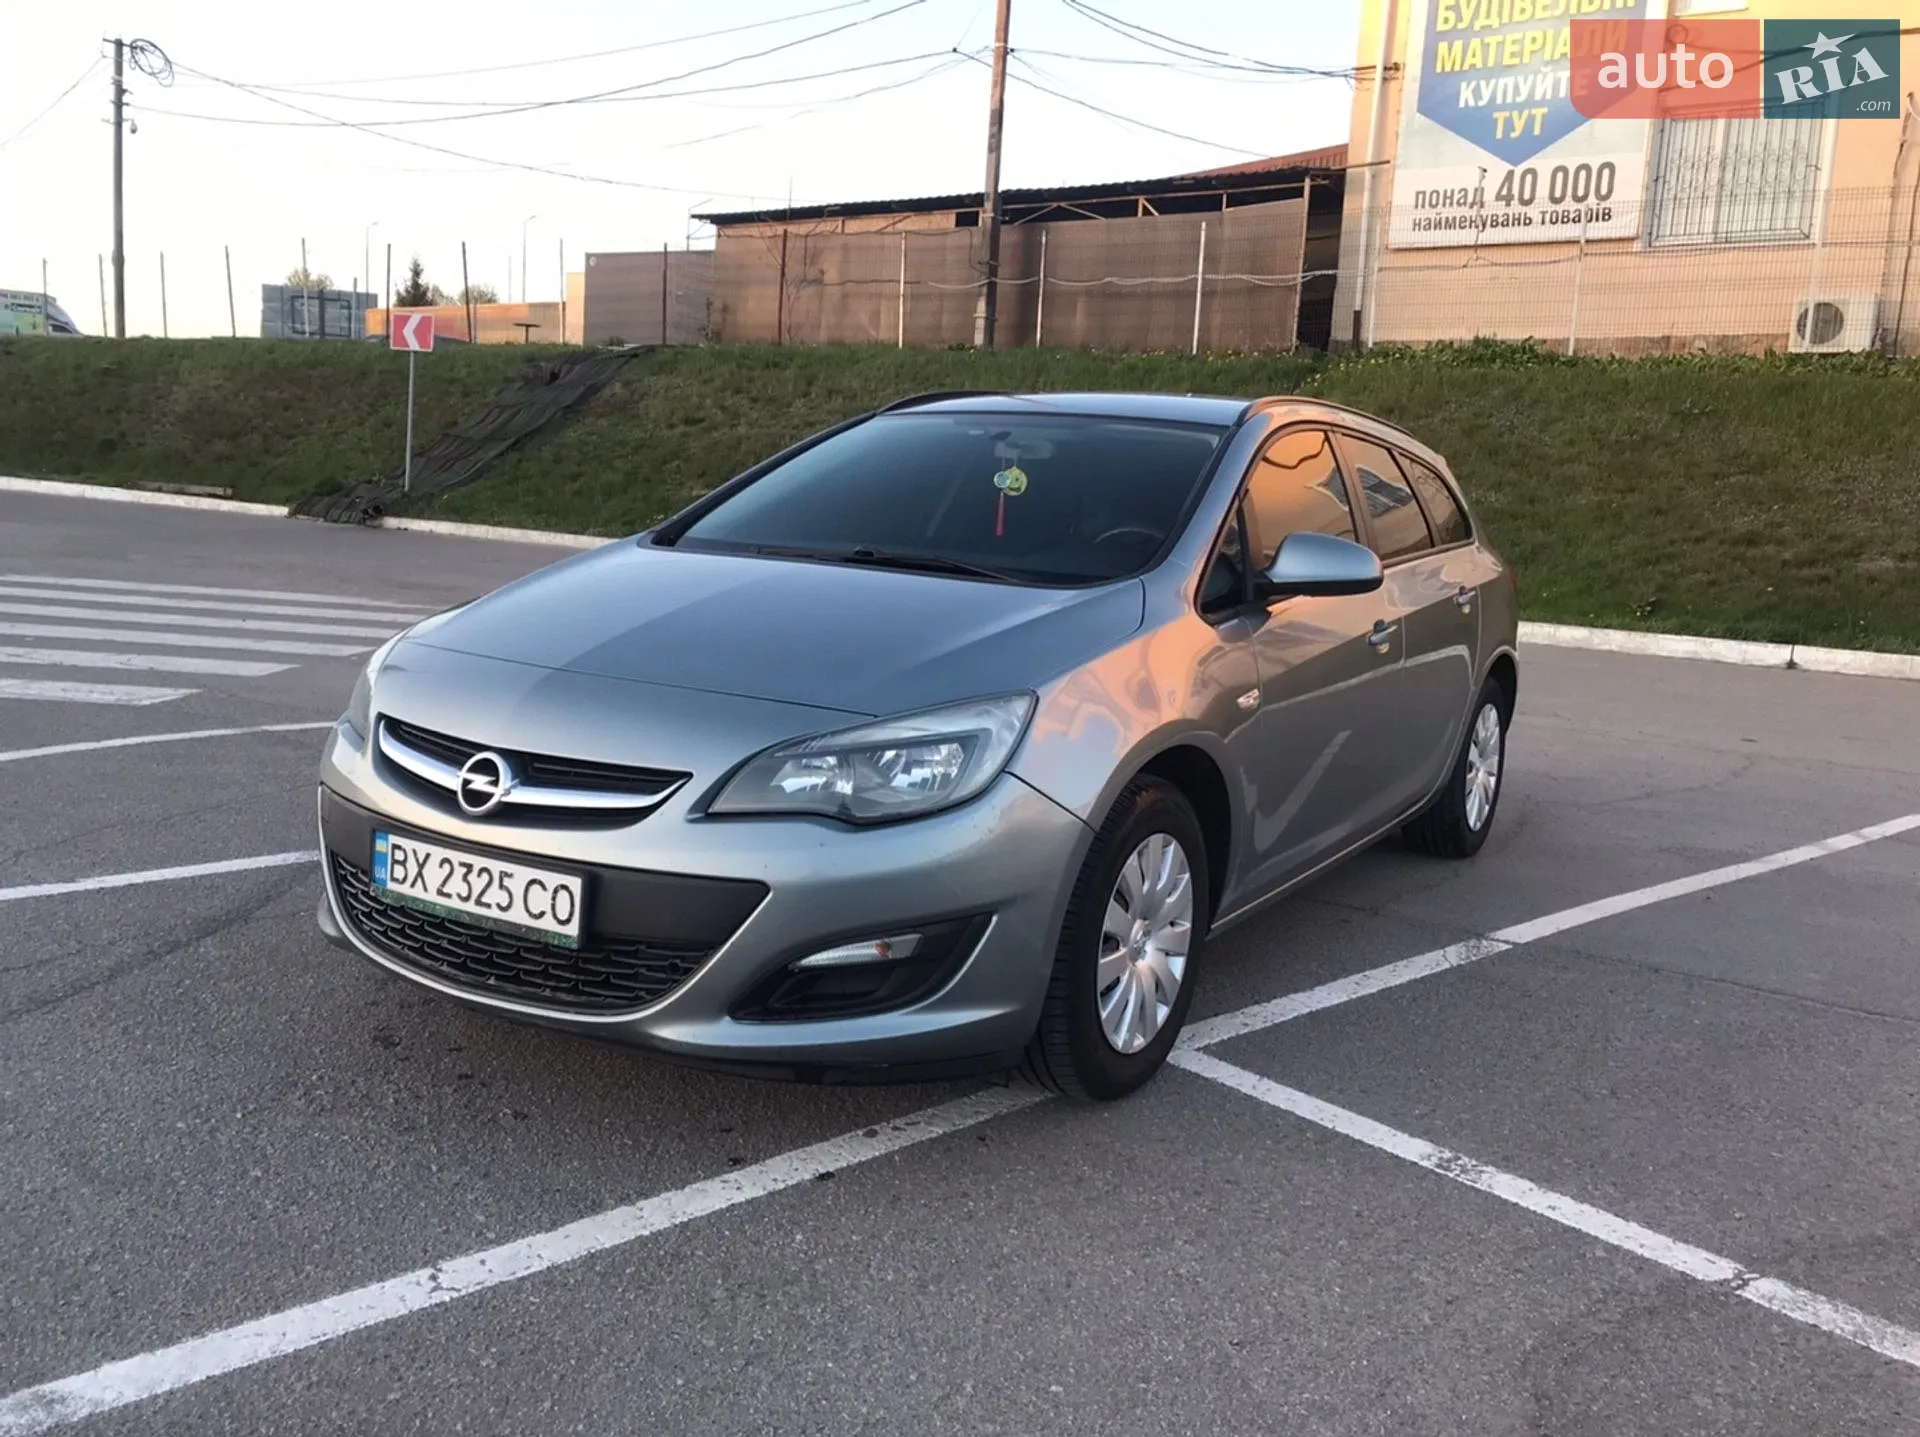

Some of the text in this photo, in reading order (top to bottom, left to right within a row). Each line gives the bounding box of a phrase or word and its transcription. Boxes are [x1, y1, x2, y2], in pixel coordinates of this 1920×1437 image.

[1435, 0, 1636, 32] БУДІВЕ
[1435, 20, 1629, 73] МАТЕРІАЛИ
[1458, 65, 1592, 108] КУПУЙТЕ
[1492, 107, 1548, 139] ТУТ
[1414, 161, 1616, 210] понад 40 000
[1412, 204, 1612, 232] найменувань товарів
[389, 843, 432, 893] BX
[436, 857, 514, 913] 2325
[522, 878, 575, 926] CO
